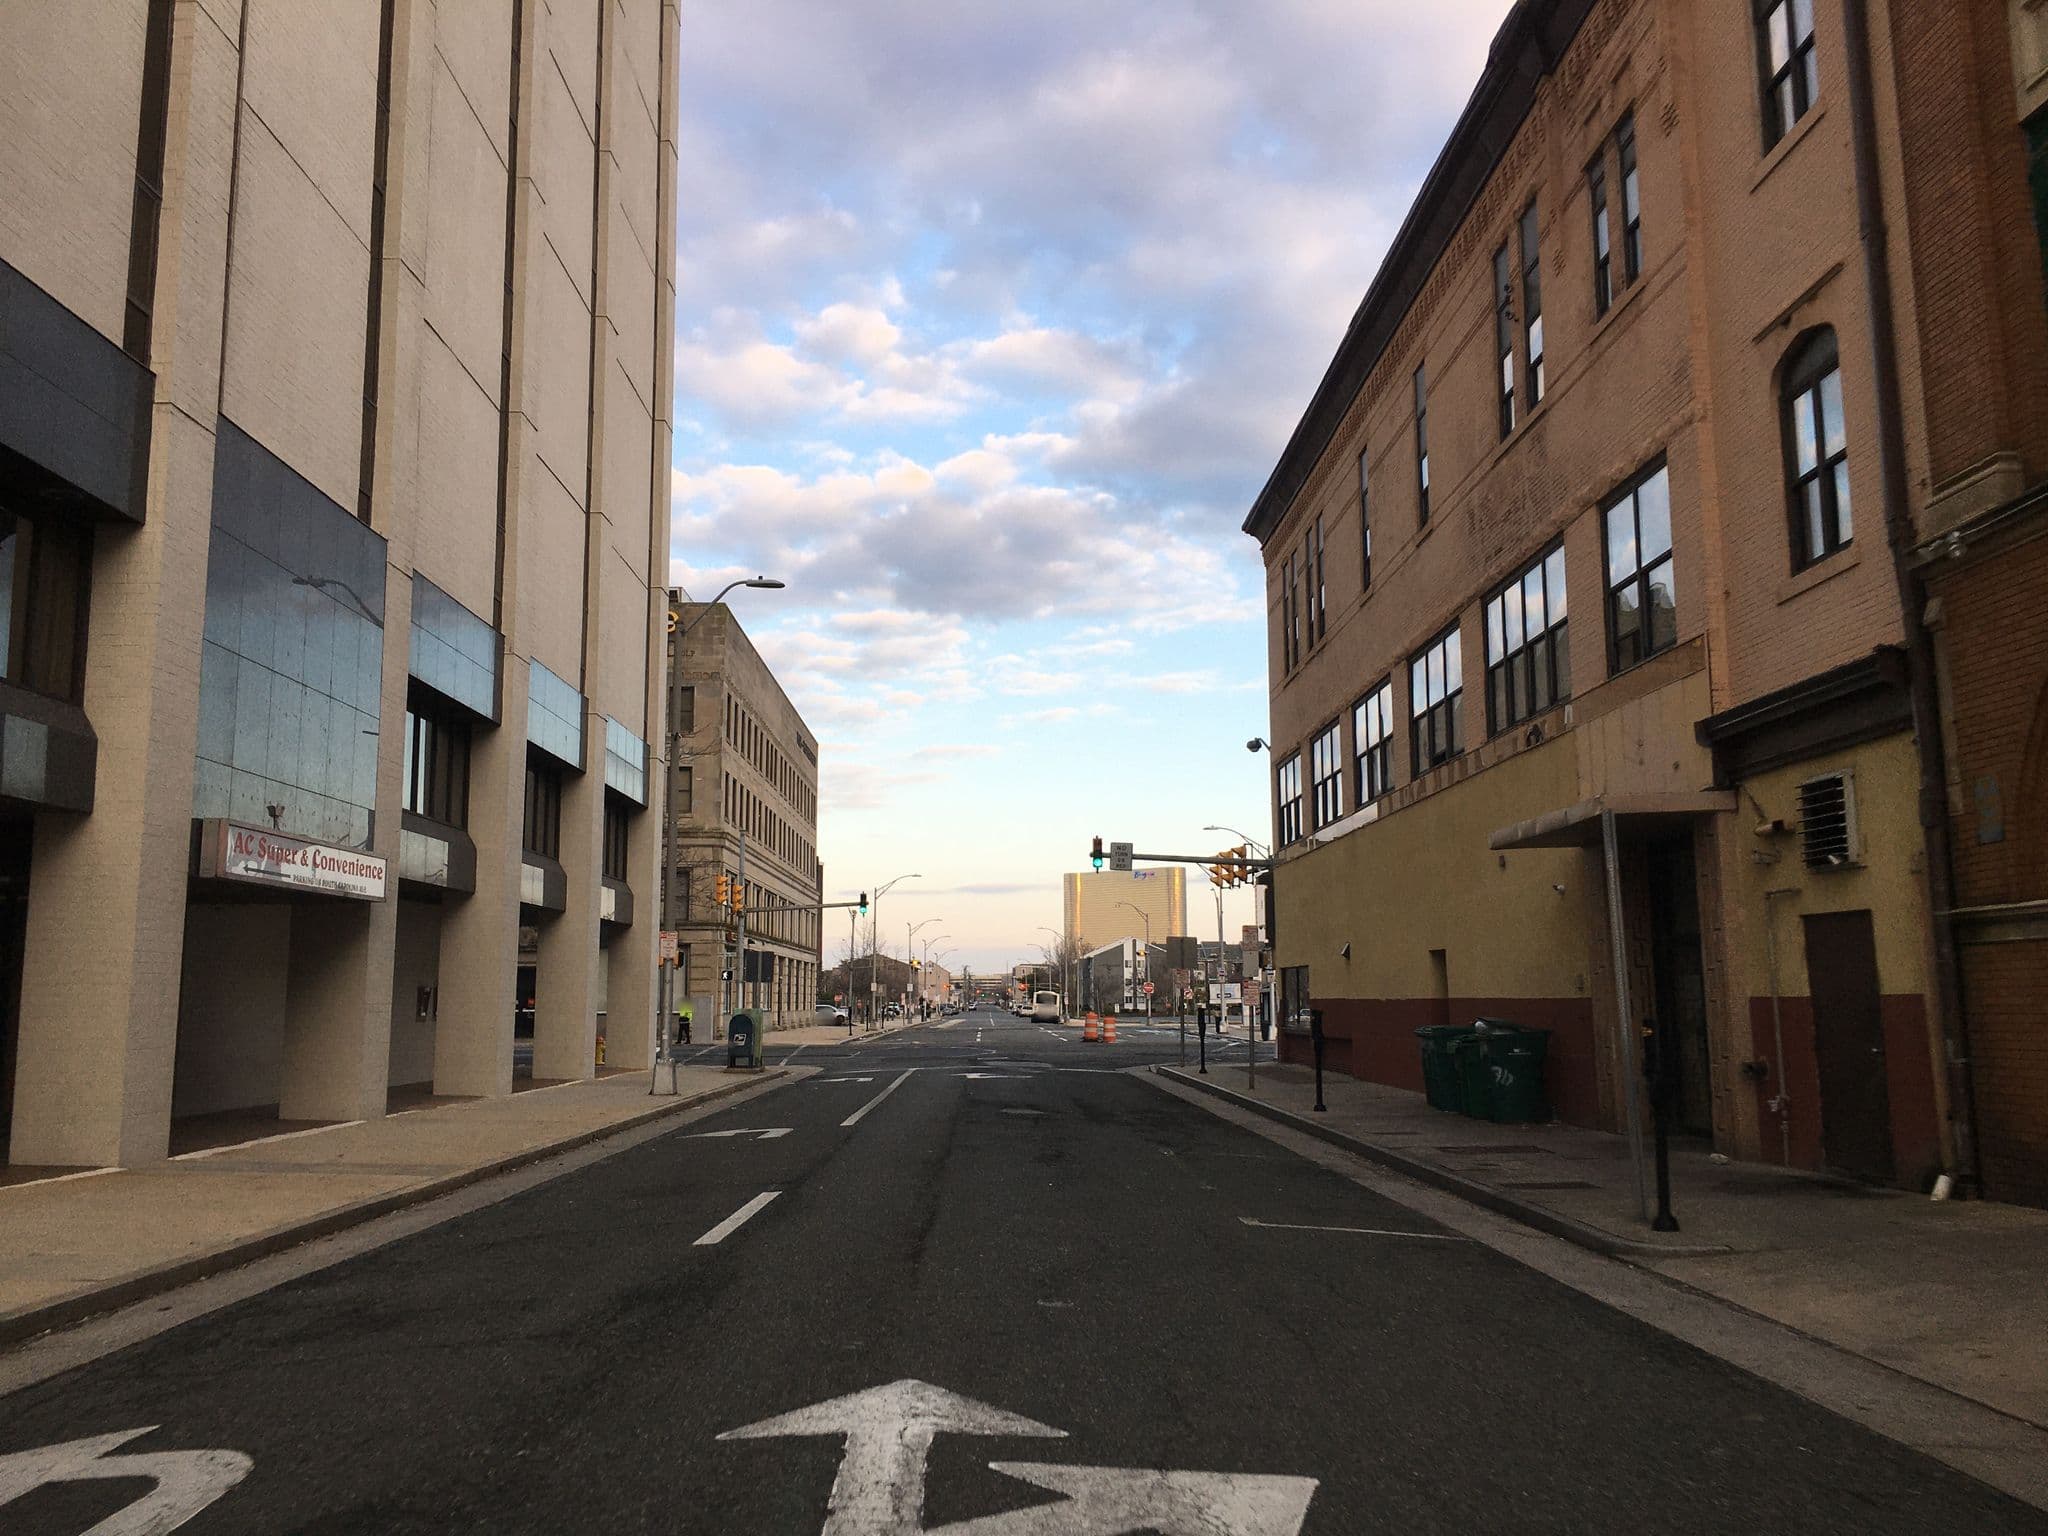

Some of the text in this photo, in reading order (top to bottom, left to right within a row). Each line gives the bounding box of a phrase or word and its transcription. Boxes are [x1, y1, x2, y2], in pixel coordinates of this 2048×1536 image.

[234, 831, 383, 880] AC Super & Convenience
